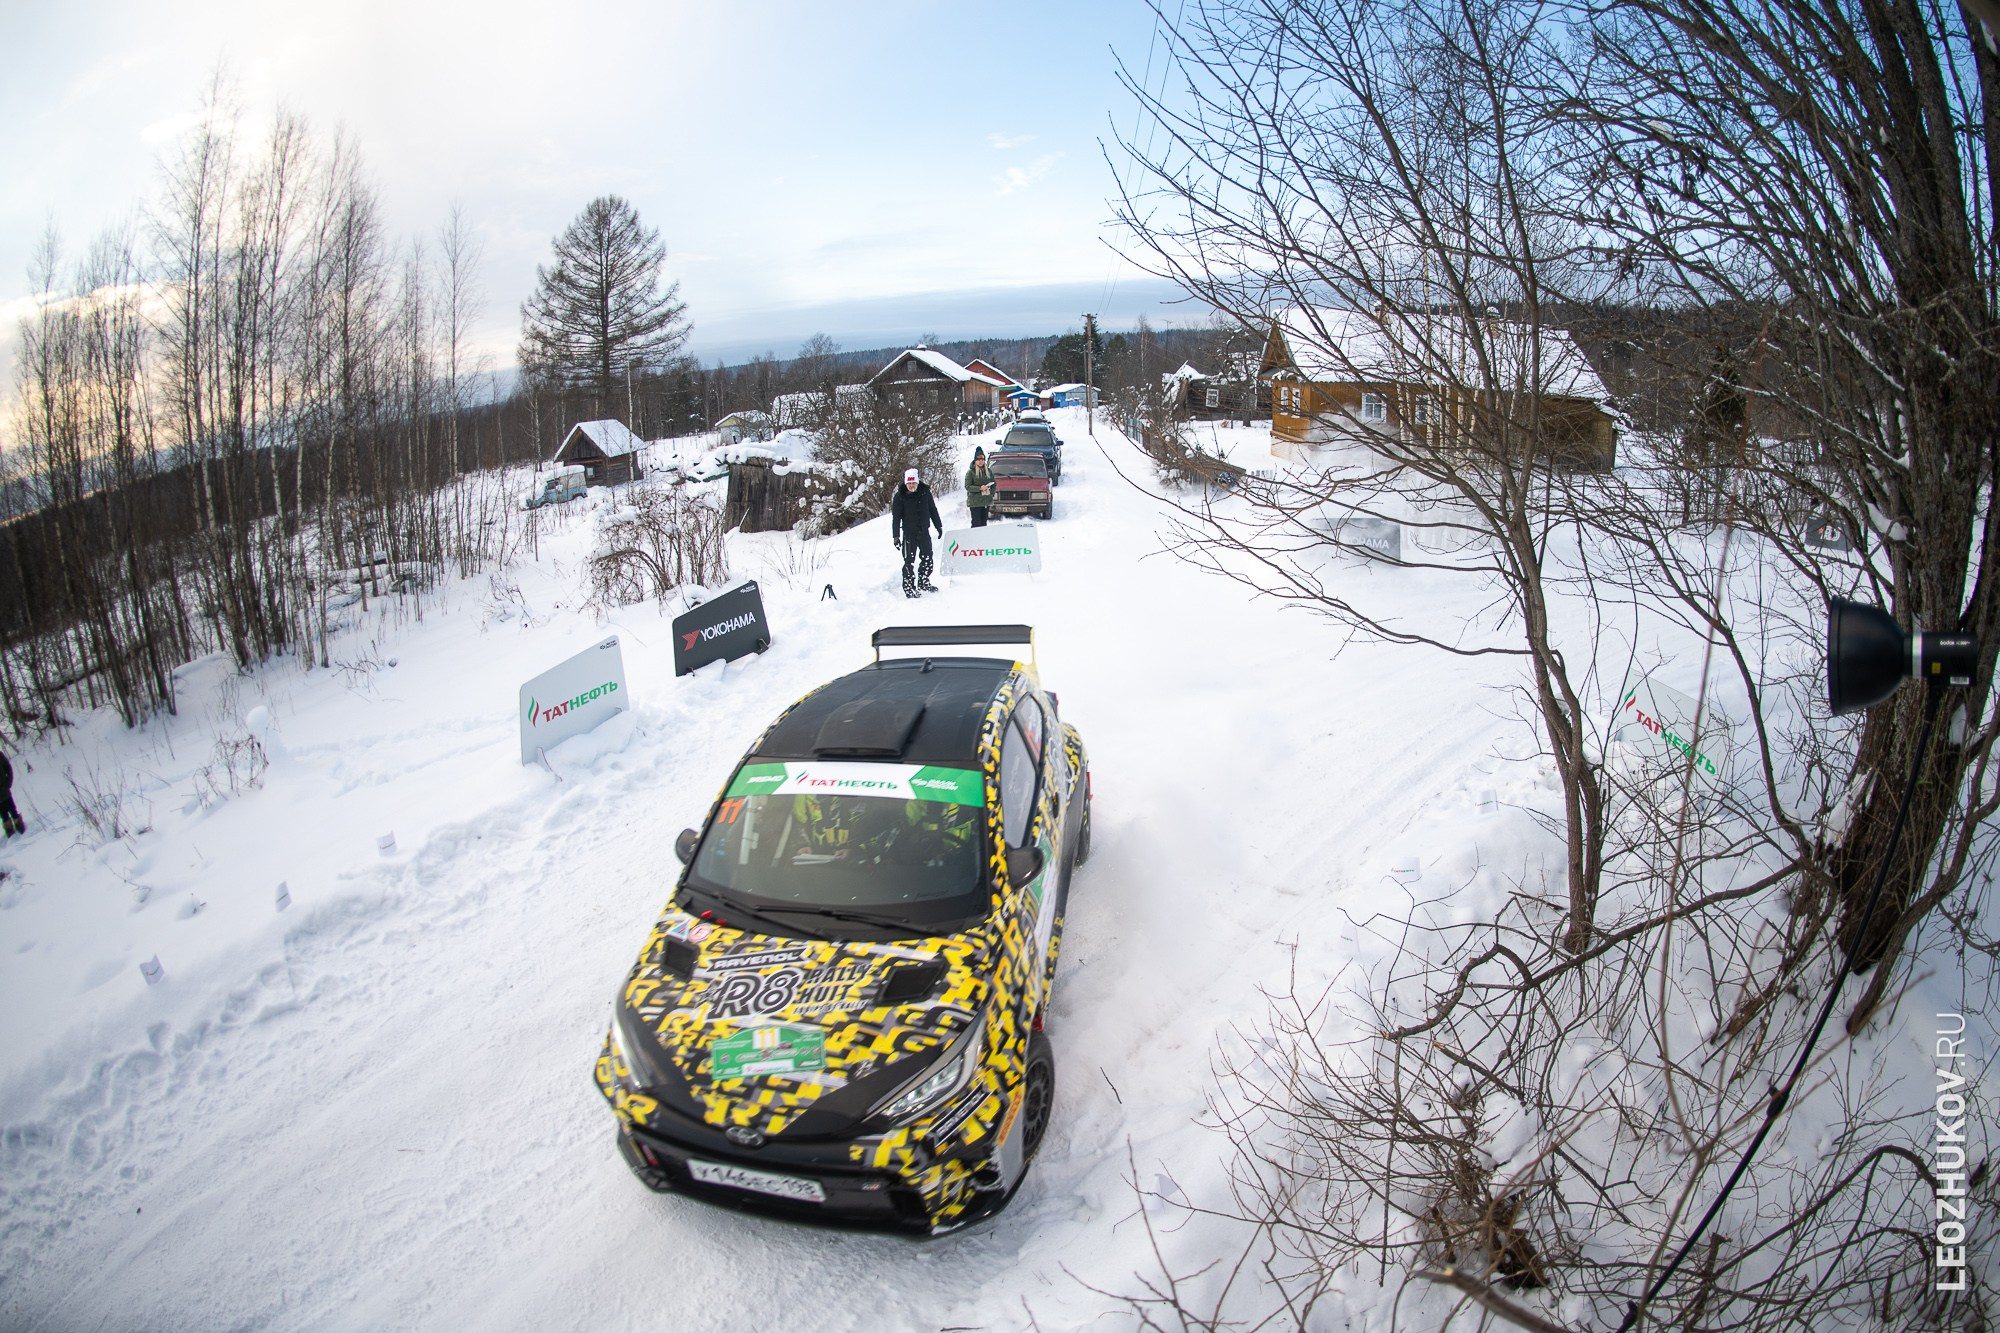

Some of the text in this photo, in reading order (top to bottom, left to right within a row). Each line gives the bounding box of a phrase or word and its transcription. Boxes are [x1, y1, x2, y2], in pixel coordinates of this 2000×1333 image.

[961, 547, 1032, 557] ТАТНЕФТЬ
[700, 611, 756, 642] YOKOHAMA
[543, 680, 618, 723] ТАТНЕФТЬ
[810, 778, 898, 790] ТАТНЕФТЬ
[719, 799, 745, 824] 11
[714, 951, 799, 969] RAVENOL
[806, 964, 873, 984] RALLY
[755, 1027, 776, 1049] 11
